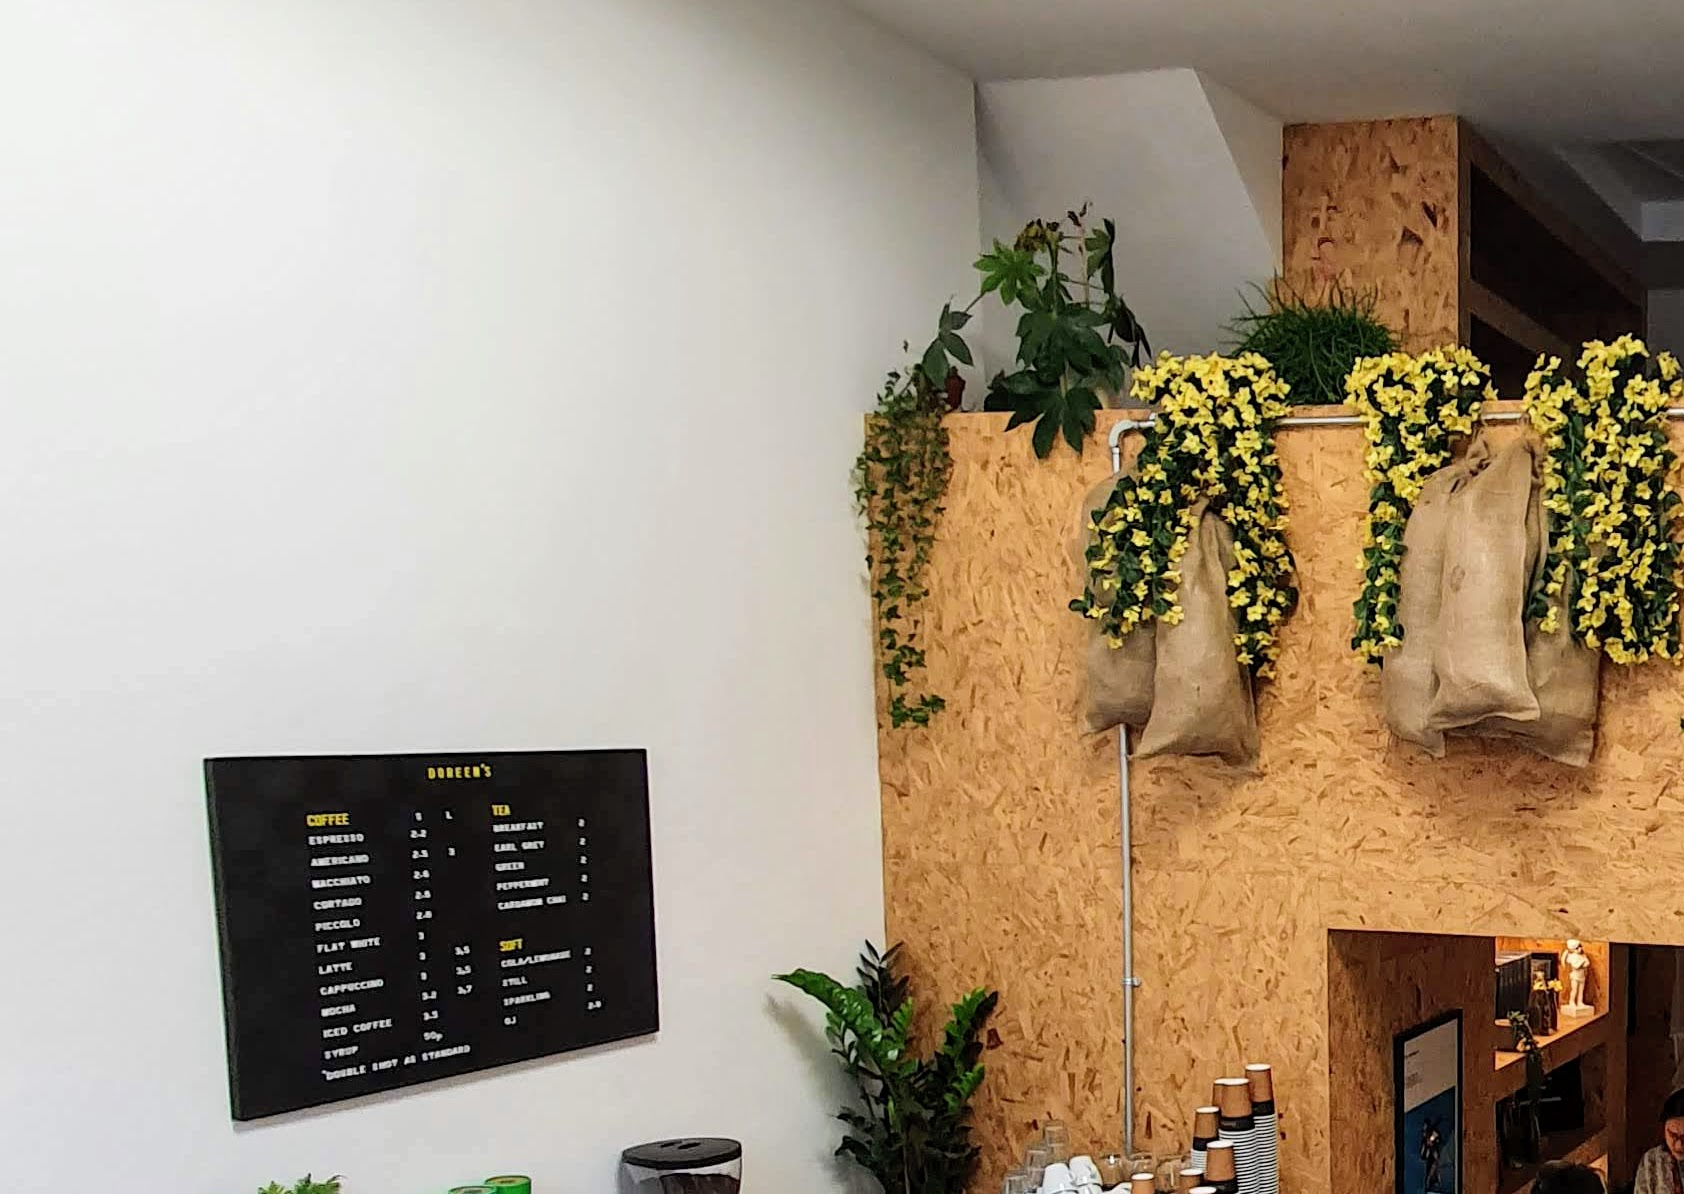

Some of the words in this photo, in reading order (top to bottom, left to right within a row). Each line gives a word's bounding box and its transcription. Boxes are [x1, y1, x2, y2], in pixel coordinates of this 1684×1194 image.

[427, 763, 492, 780] DOREEN'S
[491, 804, 511, 817] TEA
[306, 812, 350, 827] COFFEE
[492, 821, 544, 833] BREAKFAST
[308, 833, 365, 846] ESPRESSO
[493, 842, 518, 853] EARL
[521, 840, 545, 850] GREY
[310, 854, 370, 867] AMERICANO
[494, 861, 525, 872] GREEN
[311, 875, 371, 889] MACCHIATO
[496, 877, 550, 891] PEPPERMINT
[313, 897, 363, 910] CORTADO
[314, 918, 361, 932] PICCOLO
[316, 941, 346, 954] FLAT
[349, 936, 381, 949] WHITE
[499, 938, 523, 952] SOFT
[318, 961, 353, 975] LATTE
[319, 978, 384, 996] CAPPUCCINO
[502, 976, 528, 987] STILL
[503, 991, 551, 1007] SPARKLING
[320, 1003, 356, 1018] MOCHA
[503, 1016, 517, 1026] OJ
[322, 1025, 348, 1039] ICED
[351, 1018, 393, 1034] COFFEE
[324, 1045, 359, 1060] SYRUP
[371, 1058, 399, 1072] SHOT
[403, 1054, 417, 1066] AS
[421, 1044, 471, 1062] STANDARD
